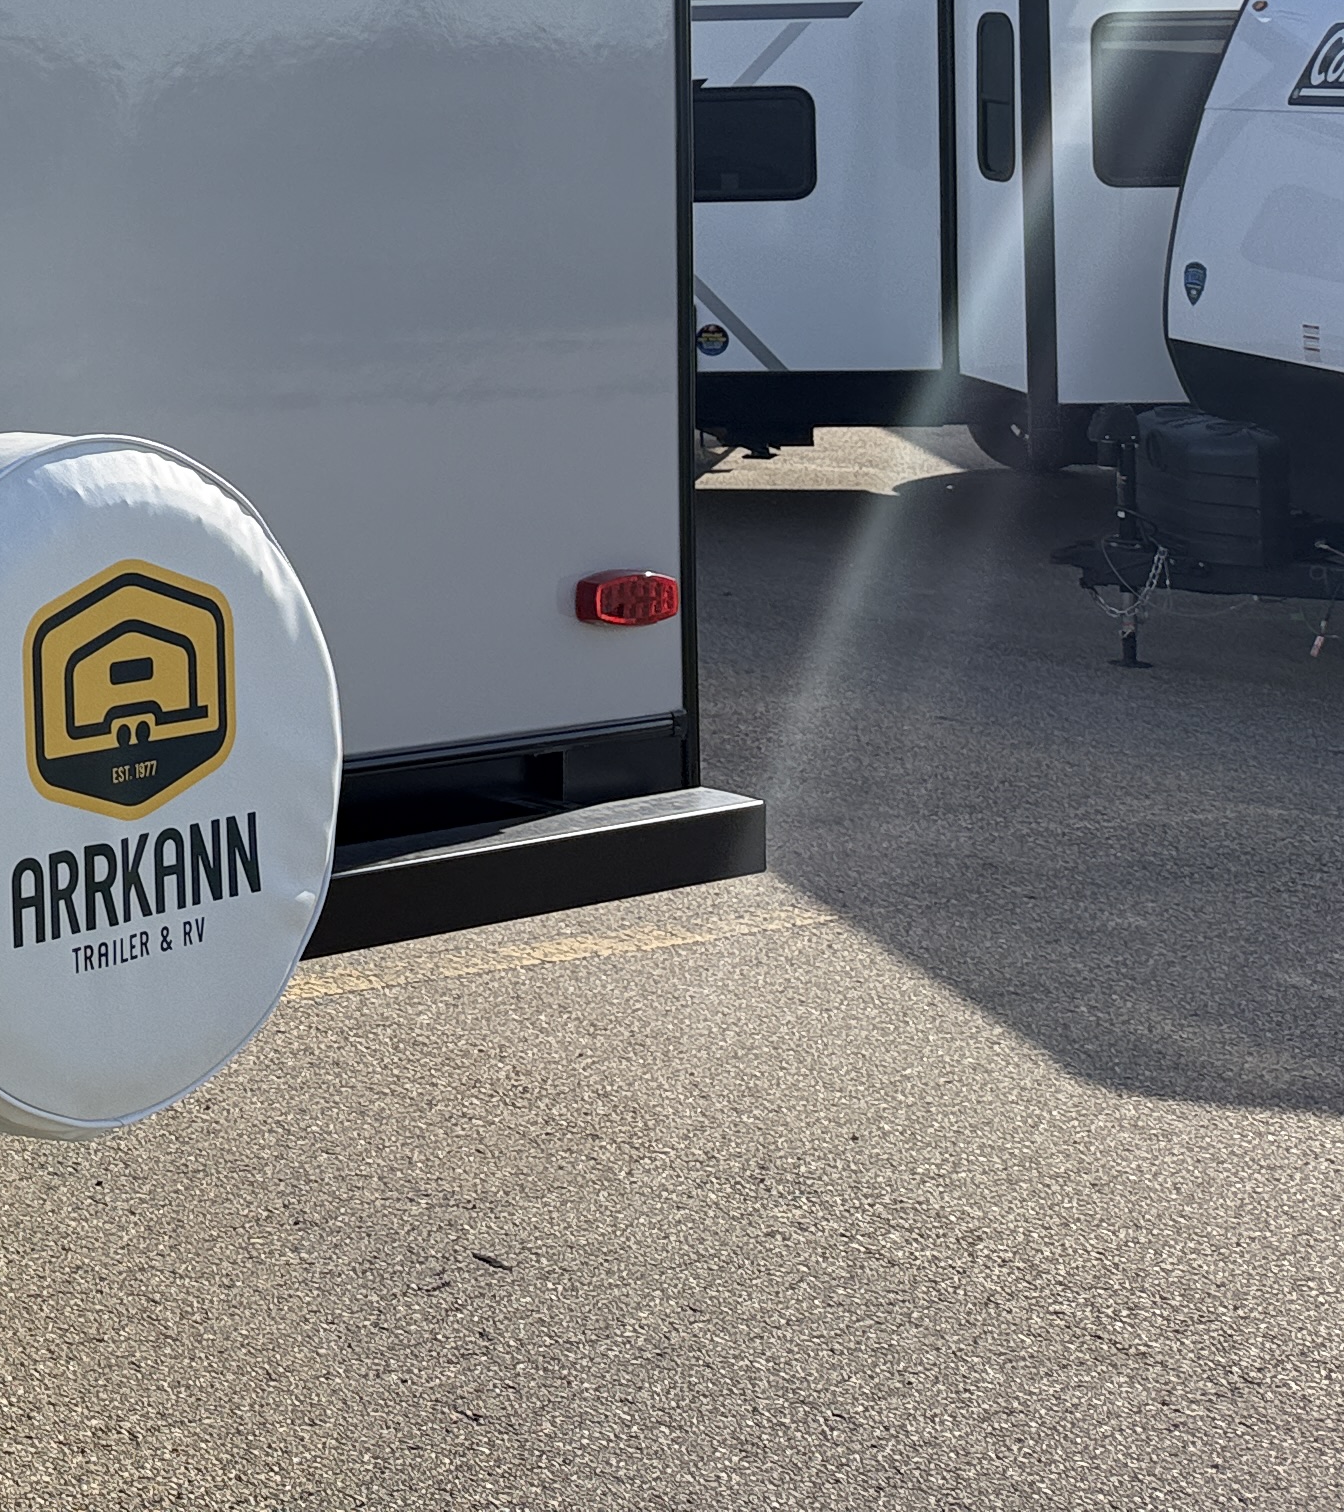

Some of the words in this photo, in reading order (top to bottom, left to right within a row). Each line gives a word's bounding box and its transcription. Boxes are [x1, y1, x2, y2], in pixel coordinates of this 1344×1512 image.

[112, 765, 133, 784] EST.
[135, 760, 158, 779] 1977
[12, 811, 262, 949] ARRKANN
[72, 930, 150, 974] TRAILER
[160, 926, 173, 952] &
[183, 916, 205, 946] RV
